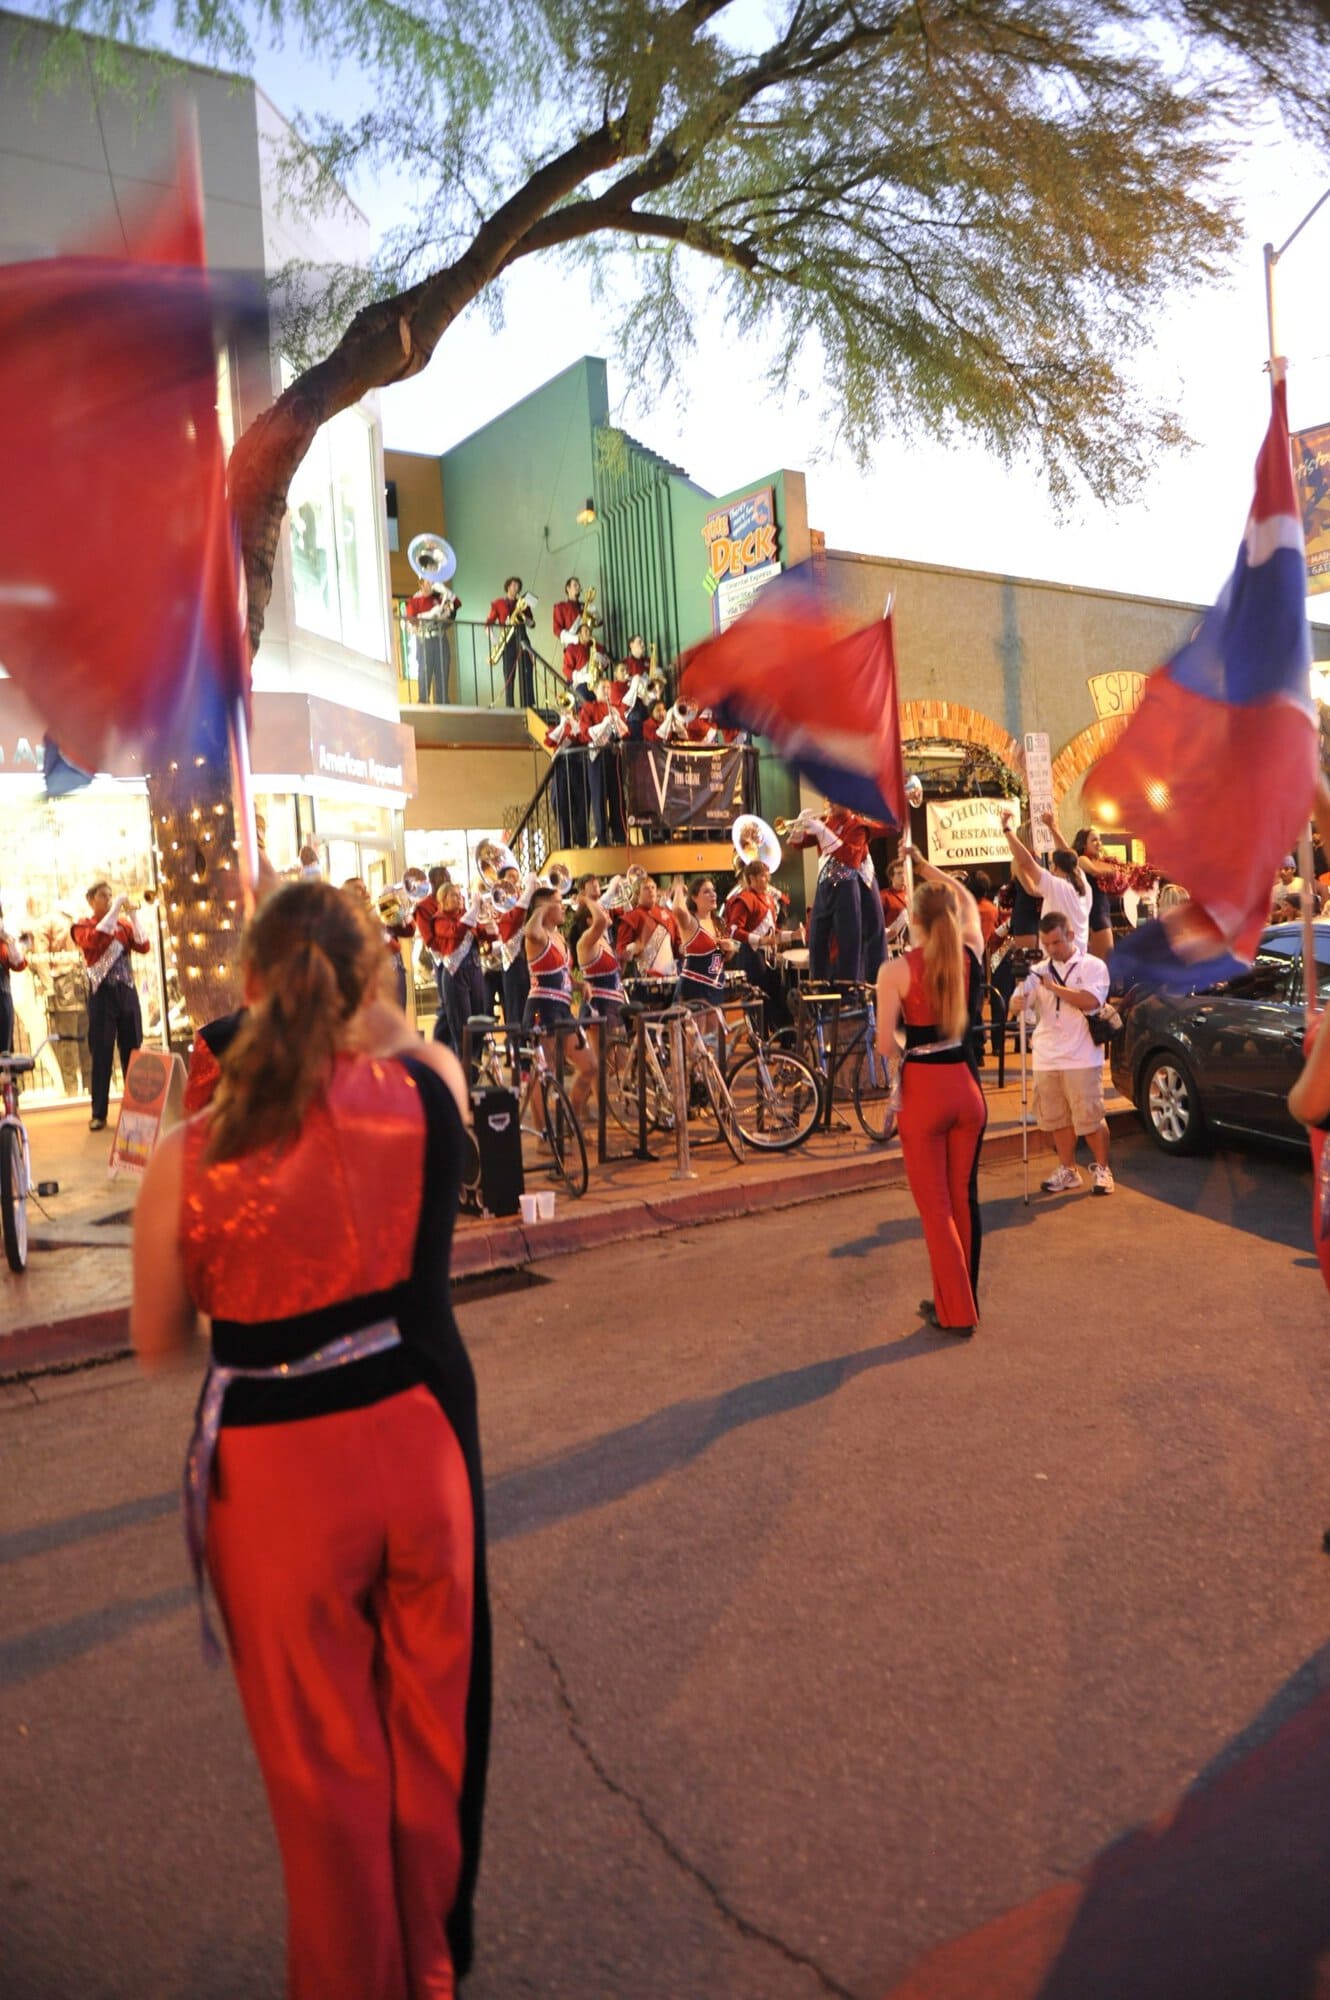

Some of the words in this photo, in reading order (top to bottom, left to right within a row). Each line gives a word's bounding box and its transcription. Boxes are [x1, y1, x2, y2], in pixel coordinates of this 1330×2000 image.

[710, 524, 777, 578] DECK
[1091, 672, 1149, 716] ESPR
[940, 801, 1003, 829] O'HUNGR
[951, 828, 1005, 841] RESTAUR
[946, 845, 994, 859] COMING
[995, 845, 1009, 856] SOO
